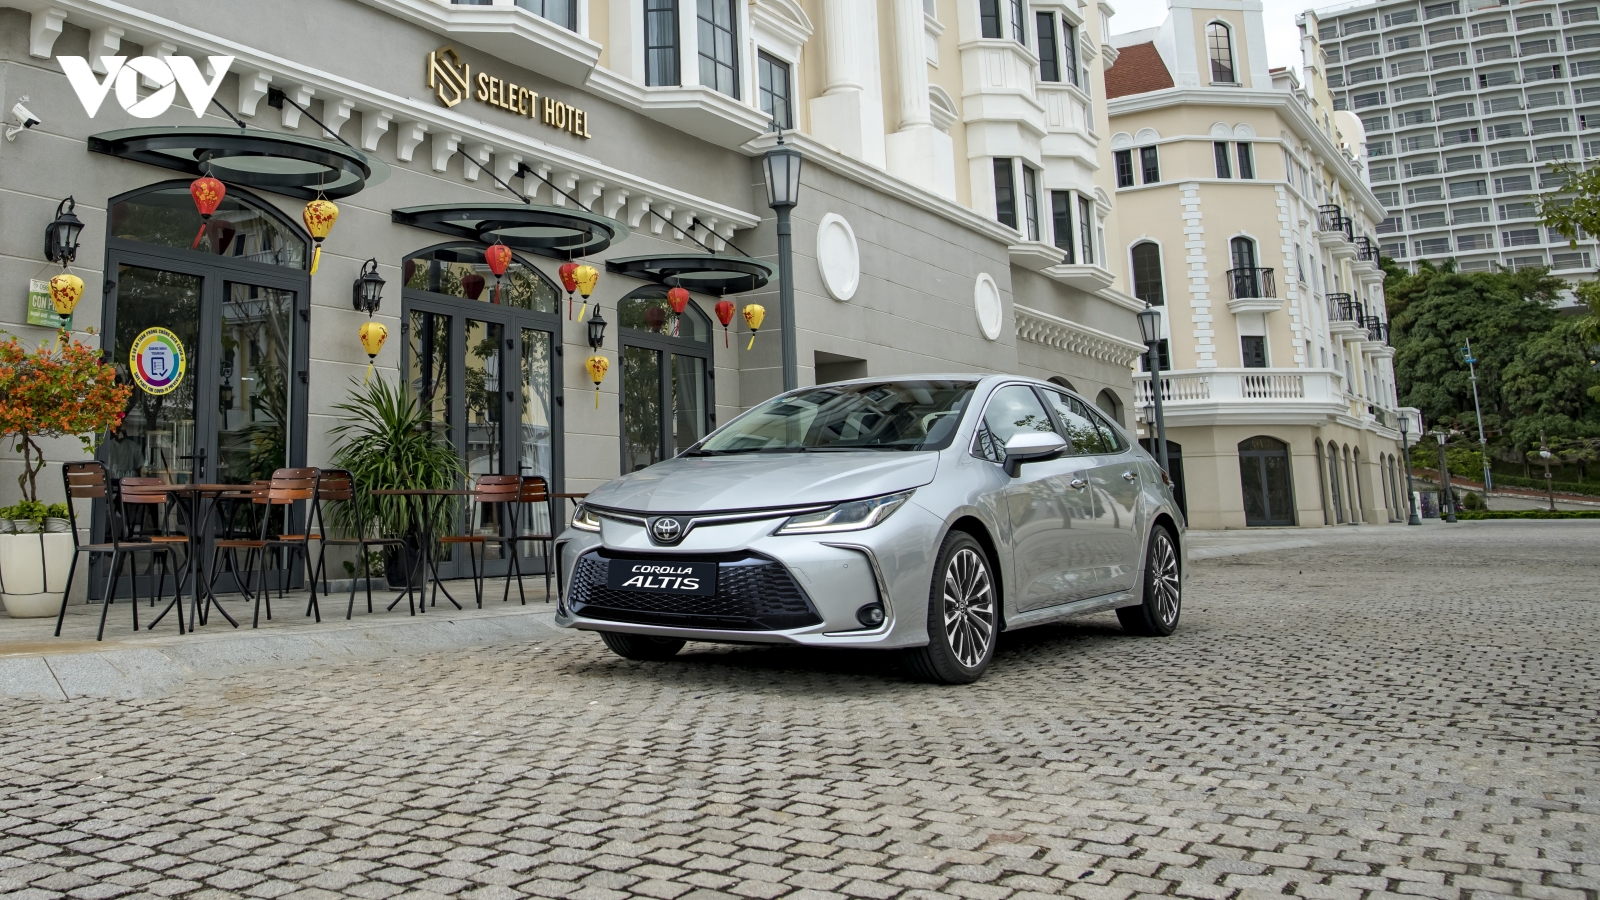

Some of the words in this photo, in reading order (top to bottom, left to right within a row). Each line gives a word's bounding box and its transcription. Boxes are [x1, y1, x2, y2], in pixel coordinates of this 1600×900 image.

[475, 72, 539, 119] SELECT
[542, 96, 592, 140] HOTEL
[631, 564, 693, 575] COROLLA
[621, 575, 700, 590] ALTIS
